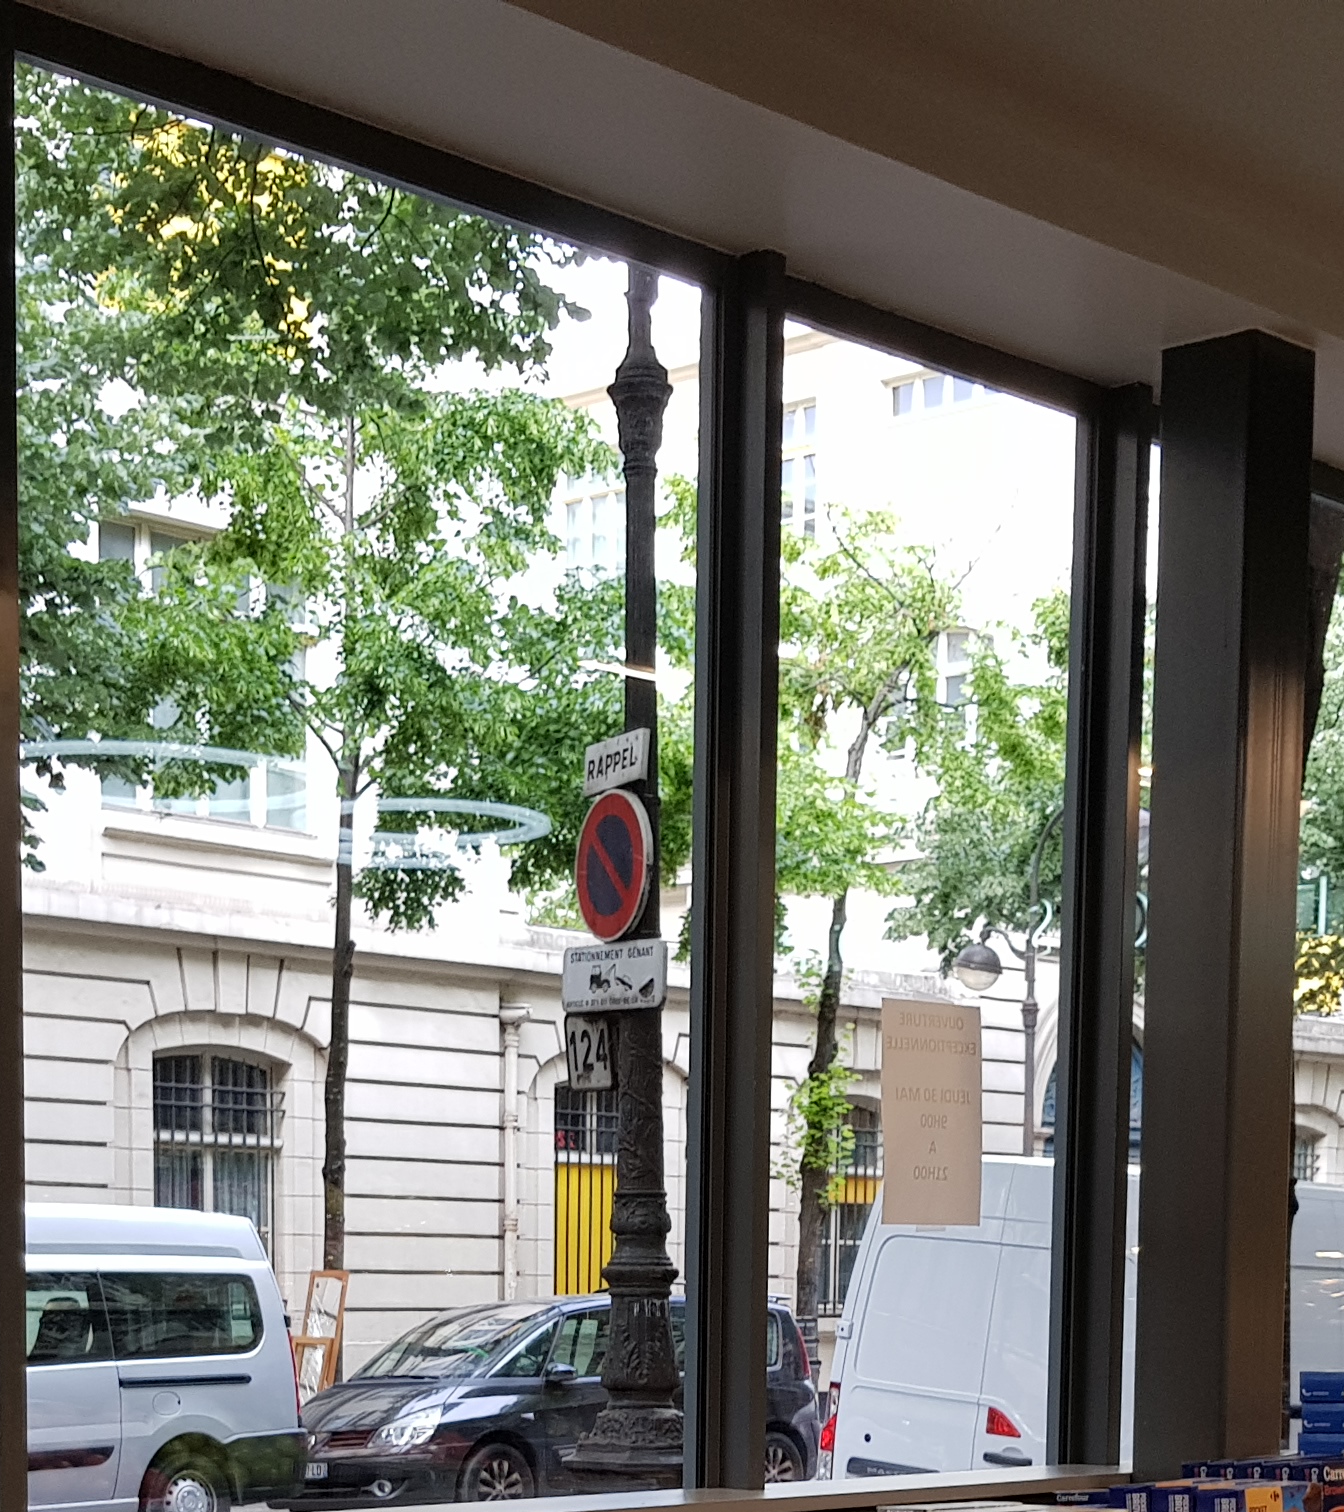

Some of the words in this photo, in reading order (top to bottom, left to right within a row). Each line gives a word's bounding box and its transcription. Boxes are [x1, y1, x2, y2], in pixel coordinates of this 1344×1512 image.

[586, 742, 638, 782] RAPPEL
[570, 949, 623, 963] STATIONNEMENT
[569, 1028, 608, 1072] 124
